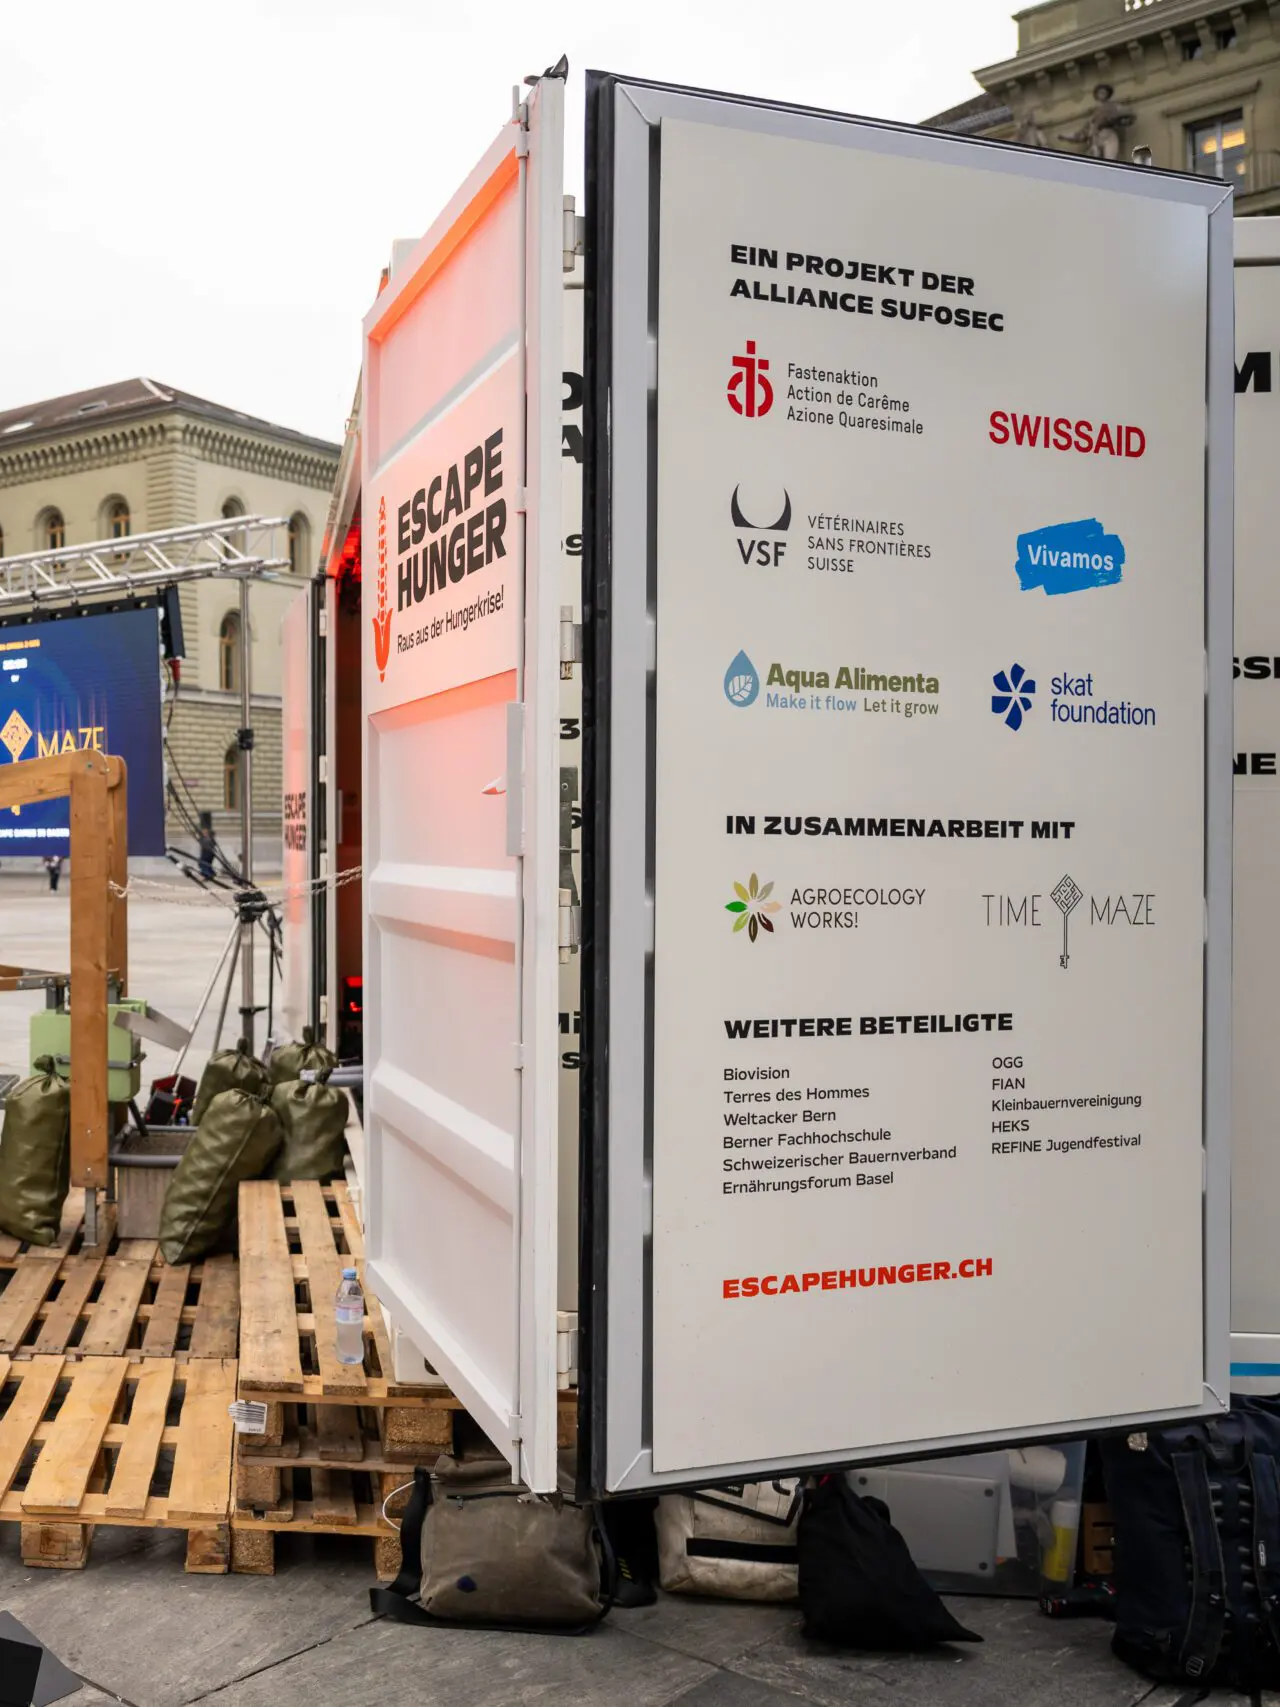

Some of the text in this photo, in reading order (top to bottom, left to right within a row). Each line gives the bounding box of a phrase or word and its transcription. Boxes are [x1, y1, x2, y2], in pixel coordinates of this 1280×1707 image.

[731, 244, 974, 296] EIN PROJEKT DER
[730, 279, 1003, 332] ALLIANCE SUFOSEC
[788, 363, 877, 387] Fastenaktion
[787, 385, 909, 412] Action de Carême
[787, 406, 923, 434] Azione Quaresimale
[989, 411, 1145, 457] SWISSAID
[398, 427, 503, 555] ESCAPE
[808, 513, 904, 536] VÉTÉRINAIRES
[398, 497, 506, 612] HUNGER
[737, 539, 786, 567] VSF
[808, 536, 930, 558] SANS FRONTIÈRES
[1028, 545, 1113, 571] Vivamos
[808, 557, 853, 572] SUISSE
[398, 584, 503, 653] Raus aus der Hungerkrise!
[766, 663, 939, 693] Aqua Alimenta
[1051, 672, 1093, 696] skat
[767, 693, 938, 718] Make it flow Let it grow
[1051, 699, 1155, 725] foundation
[38, 727, 104, 759] MAZE
[727, 816, 1075, 839] IN ZUSAMMENARBEIT MIT
[791, 889, 925, 905] AGROECOLOGY
[791, 912, 857, 928] WORKS!
[982, 895, 1155, 926] TIME MAZE
[724, 1013, 1012, 1039] WEITERE BETEILIGTE
[724, 1067, 789, 1080] Biovision
[993, 1056, 1023, 1069] OGG
[724, 1088, 869, 1103] Terres des Hommes
[993, 1078, 1025, 1090] FIAN
[992, 1094, 1141, 1111] Kleinbauernvereinigung
[724, 1110, 835, 1126] Weltacker Bern
[992, 1120, 1029, 1132] HEKS
[724, 1128, 891, 1148] Berner Fachhochschule
[992, 1134, 1140, 1154] REFINE Jugendfestival
[723, 1146, 956, 1171] Schweizerischer Bauernverband
[723, 1172, 893, 1194] Ernährungsforum Basel
[723, 1258, 992, 1298] ESCAPEHUNGER.CH
